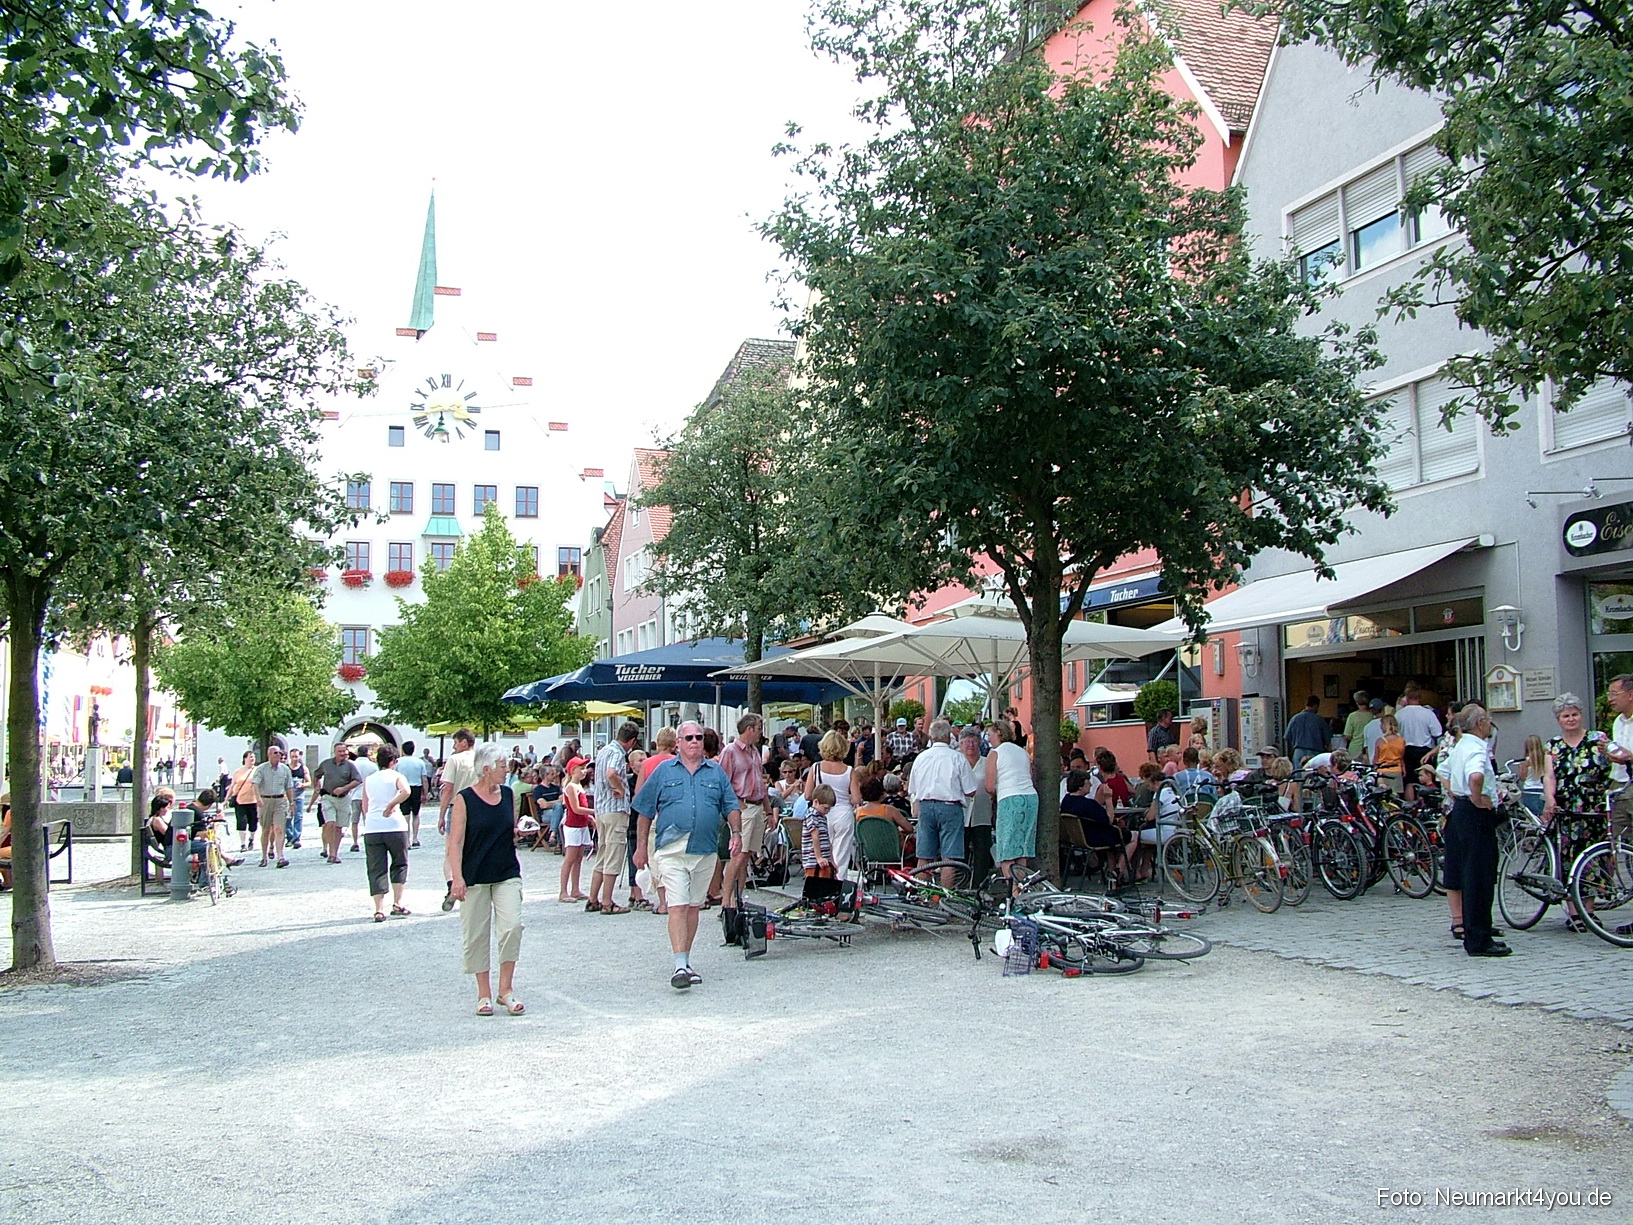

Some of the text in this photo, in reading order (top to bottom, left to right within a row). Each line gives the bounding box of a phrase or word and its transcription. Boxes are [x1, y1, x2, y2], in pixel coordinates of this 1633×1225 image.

[441, 373, 451, 388] XII
[414, 387, 429, 400] X
[1110, 588, 1139, 602] Tucher
[615, 664, 666, 675] Tucher
[618, 673, 662, 682] WEIZENBIER
